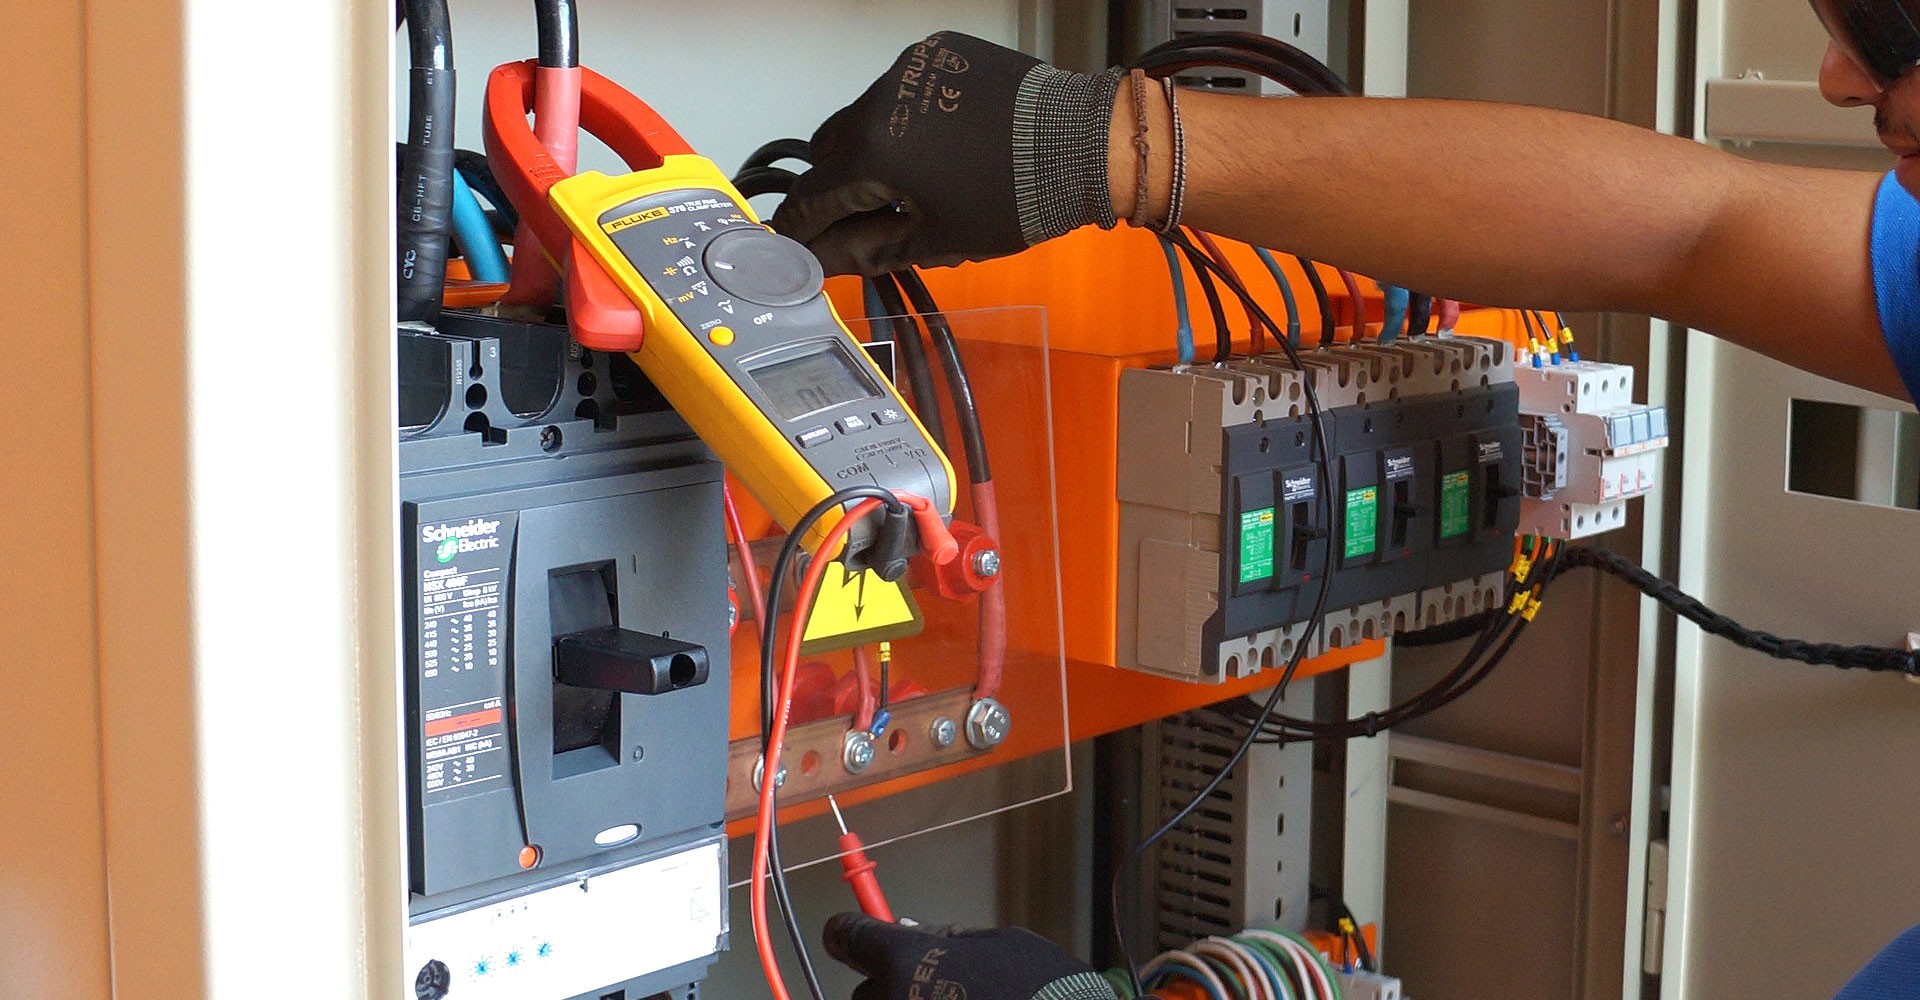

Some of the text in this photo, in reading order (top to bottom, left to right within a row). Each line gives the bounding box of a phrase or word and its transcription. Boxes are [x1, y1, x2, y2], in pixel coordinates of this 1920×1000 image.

[423, 114, 433, 146] TUBE
[611, 208, 664, 230] FLUKE
[662, 236, 678, 246] Hz
[677, 291, 696, 304] mV
[700, 318, 723, 330] ZERO
[752, 312, 774, 326] OFF
[489, 346, 497, 358] 3
[836, 462, 870, 480] COM
[423, 519, 501, 543] Schneider
[458, 535, 500, 553] Electric
[425, 738, 438, 747] IEC
[442, 735, 453, 743] EN
